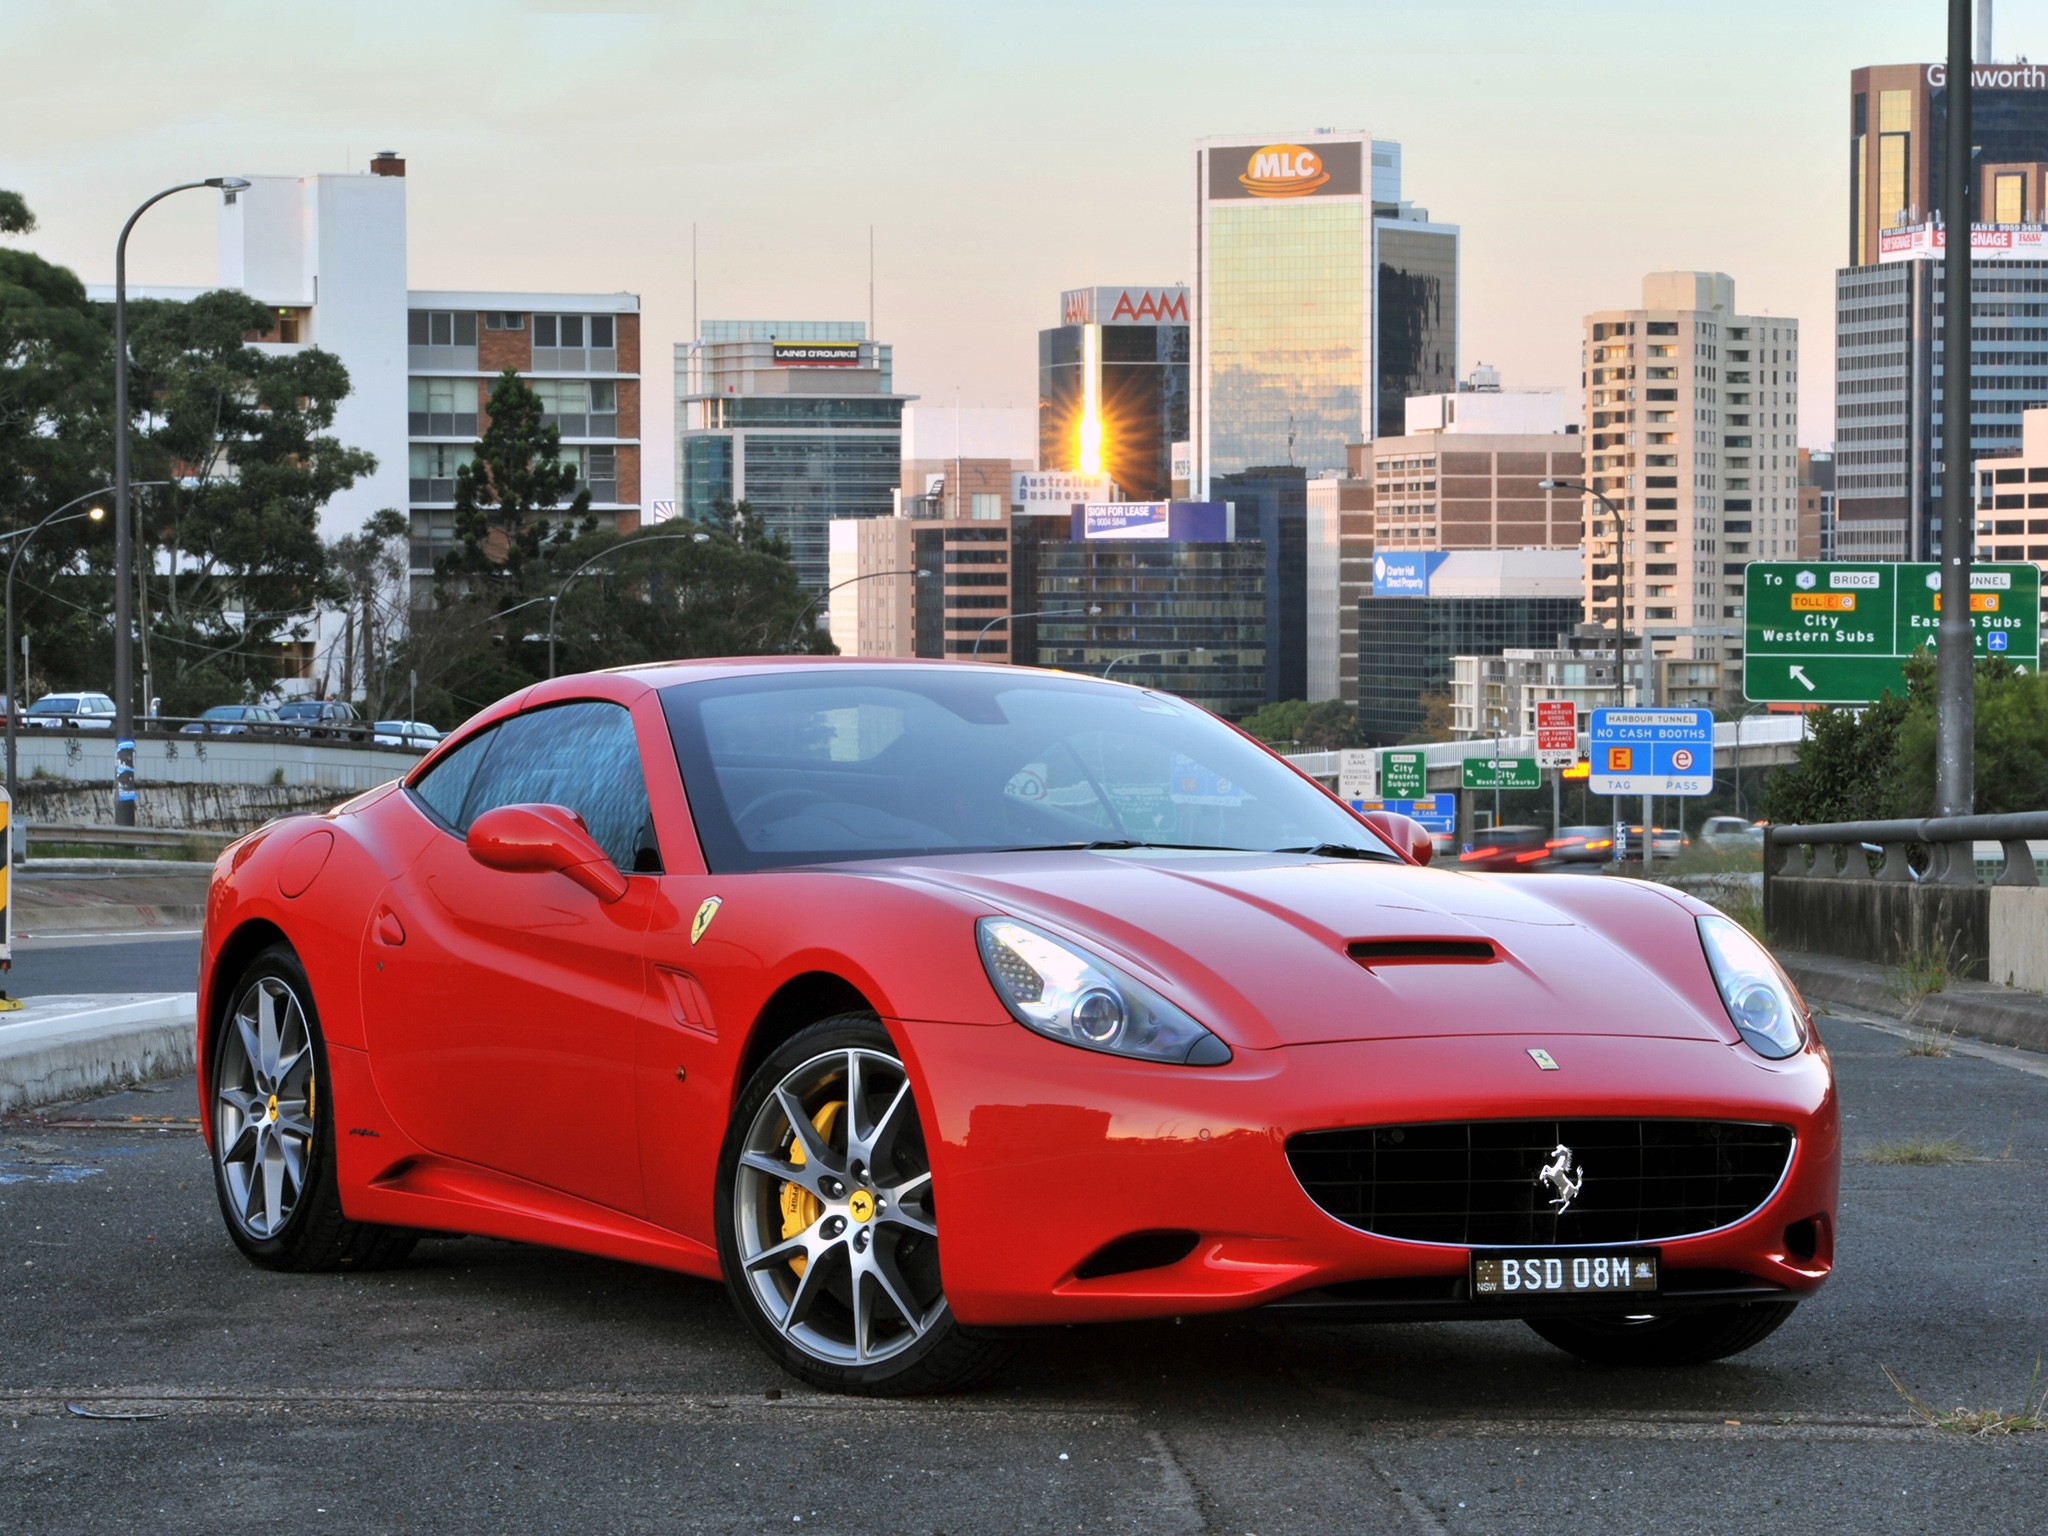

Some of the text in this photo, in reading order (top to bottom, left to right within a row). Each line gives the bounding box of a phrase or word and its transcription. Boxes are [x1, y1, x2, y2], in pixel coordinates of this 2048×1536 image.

[1926, 64, 2046, 87] Gworth
[1253, 151, 1315, 179] MLC
[1970, 231, 2008, 247] GNAGE
[1111, 290, 1189, 321] AAM
[776, 350, 857, 358] LAING O'ROURKE
[1020, 475, 1102, 488] Australian
[1019, 488, 1091, 501] Business
[1087, 506, 1107, 517] SIGN
[1107, 506, 1123, 517] FOR
[1124, 506, 1150, 517] LEASE
[1402, 577, 1423, 590] Property
[1764, 573, 1876, 586] To 4 BRIDGE
[1970, 576, 2008, 586] UNNEL
[1793, 597, 1822, 607] TOLL
[1826, 597, 1835, 607] E
[1804, 614, 1839, 629] City
[1911, 615, 2022, 628] Easn Subs
[1762, 630, 1875, 643] Western Subs
[1608, 714, 1695, 725] HARBOUR TUNNEL
[1597, 728, 1706, 740] NO CASH BOOTHS
[1541, 750, 1572, 758] DETOUR
[1612, 750, 1627, 768] E
[1393, 764, 1415, 774] City
[1387, 780, 1420, 788] Suburbs
[1608, 780, 1699, 791] TAG PASS
[1502, 1258, 1563, 1291] BSD
[1477, 1282, 1497, 1292] NSW
